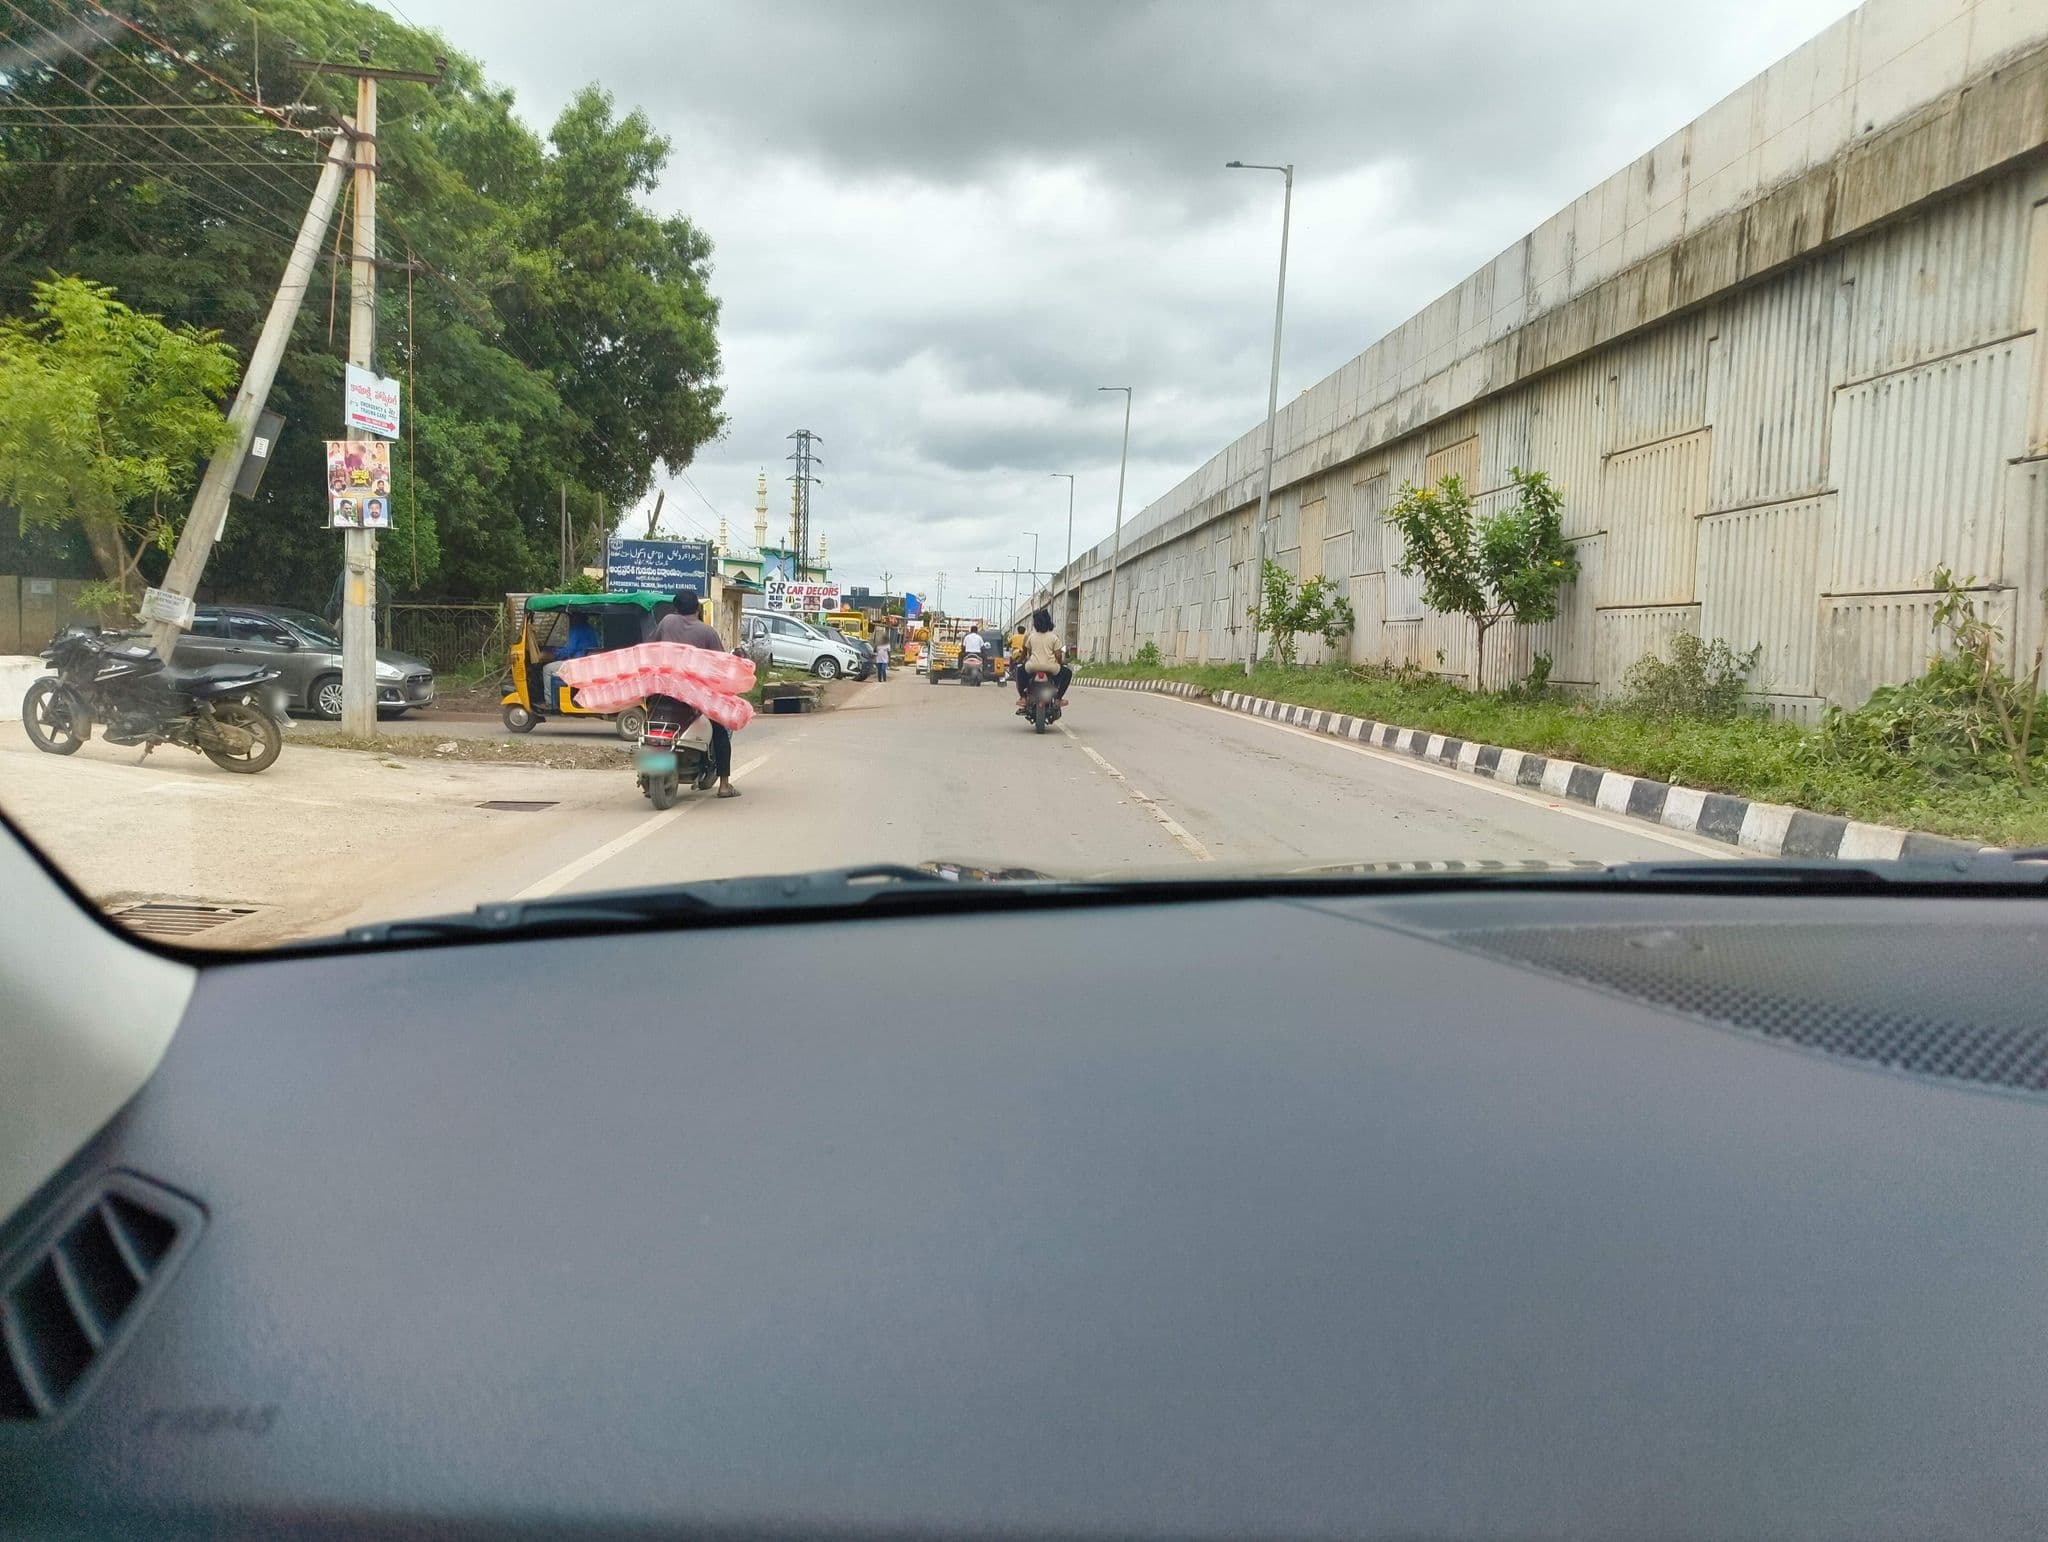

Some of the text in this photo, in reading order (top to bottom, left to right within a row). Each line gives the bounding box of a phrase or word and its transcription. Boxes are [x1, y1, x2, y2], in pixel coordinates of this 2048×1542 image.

[768, 582, 839, 596] SR CAR DECORS
